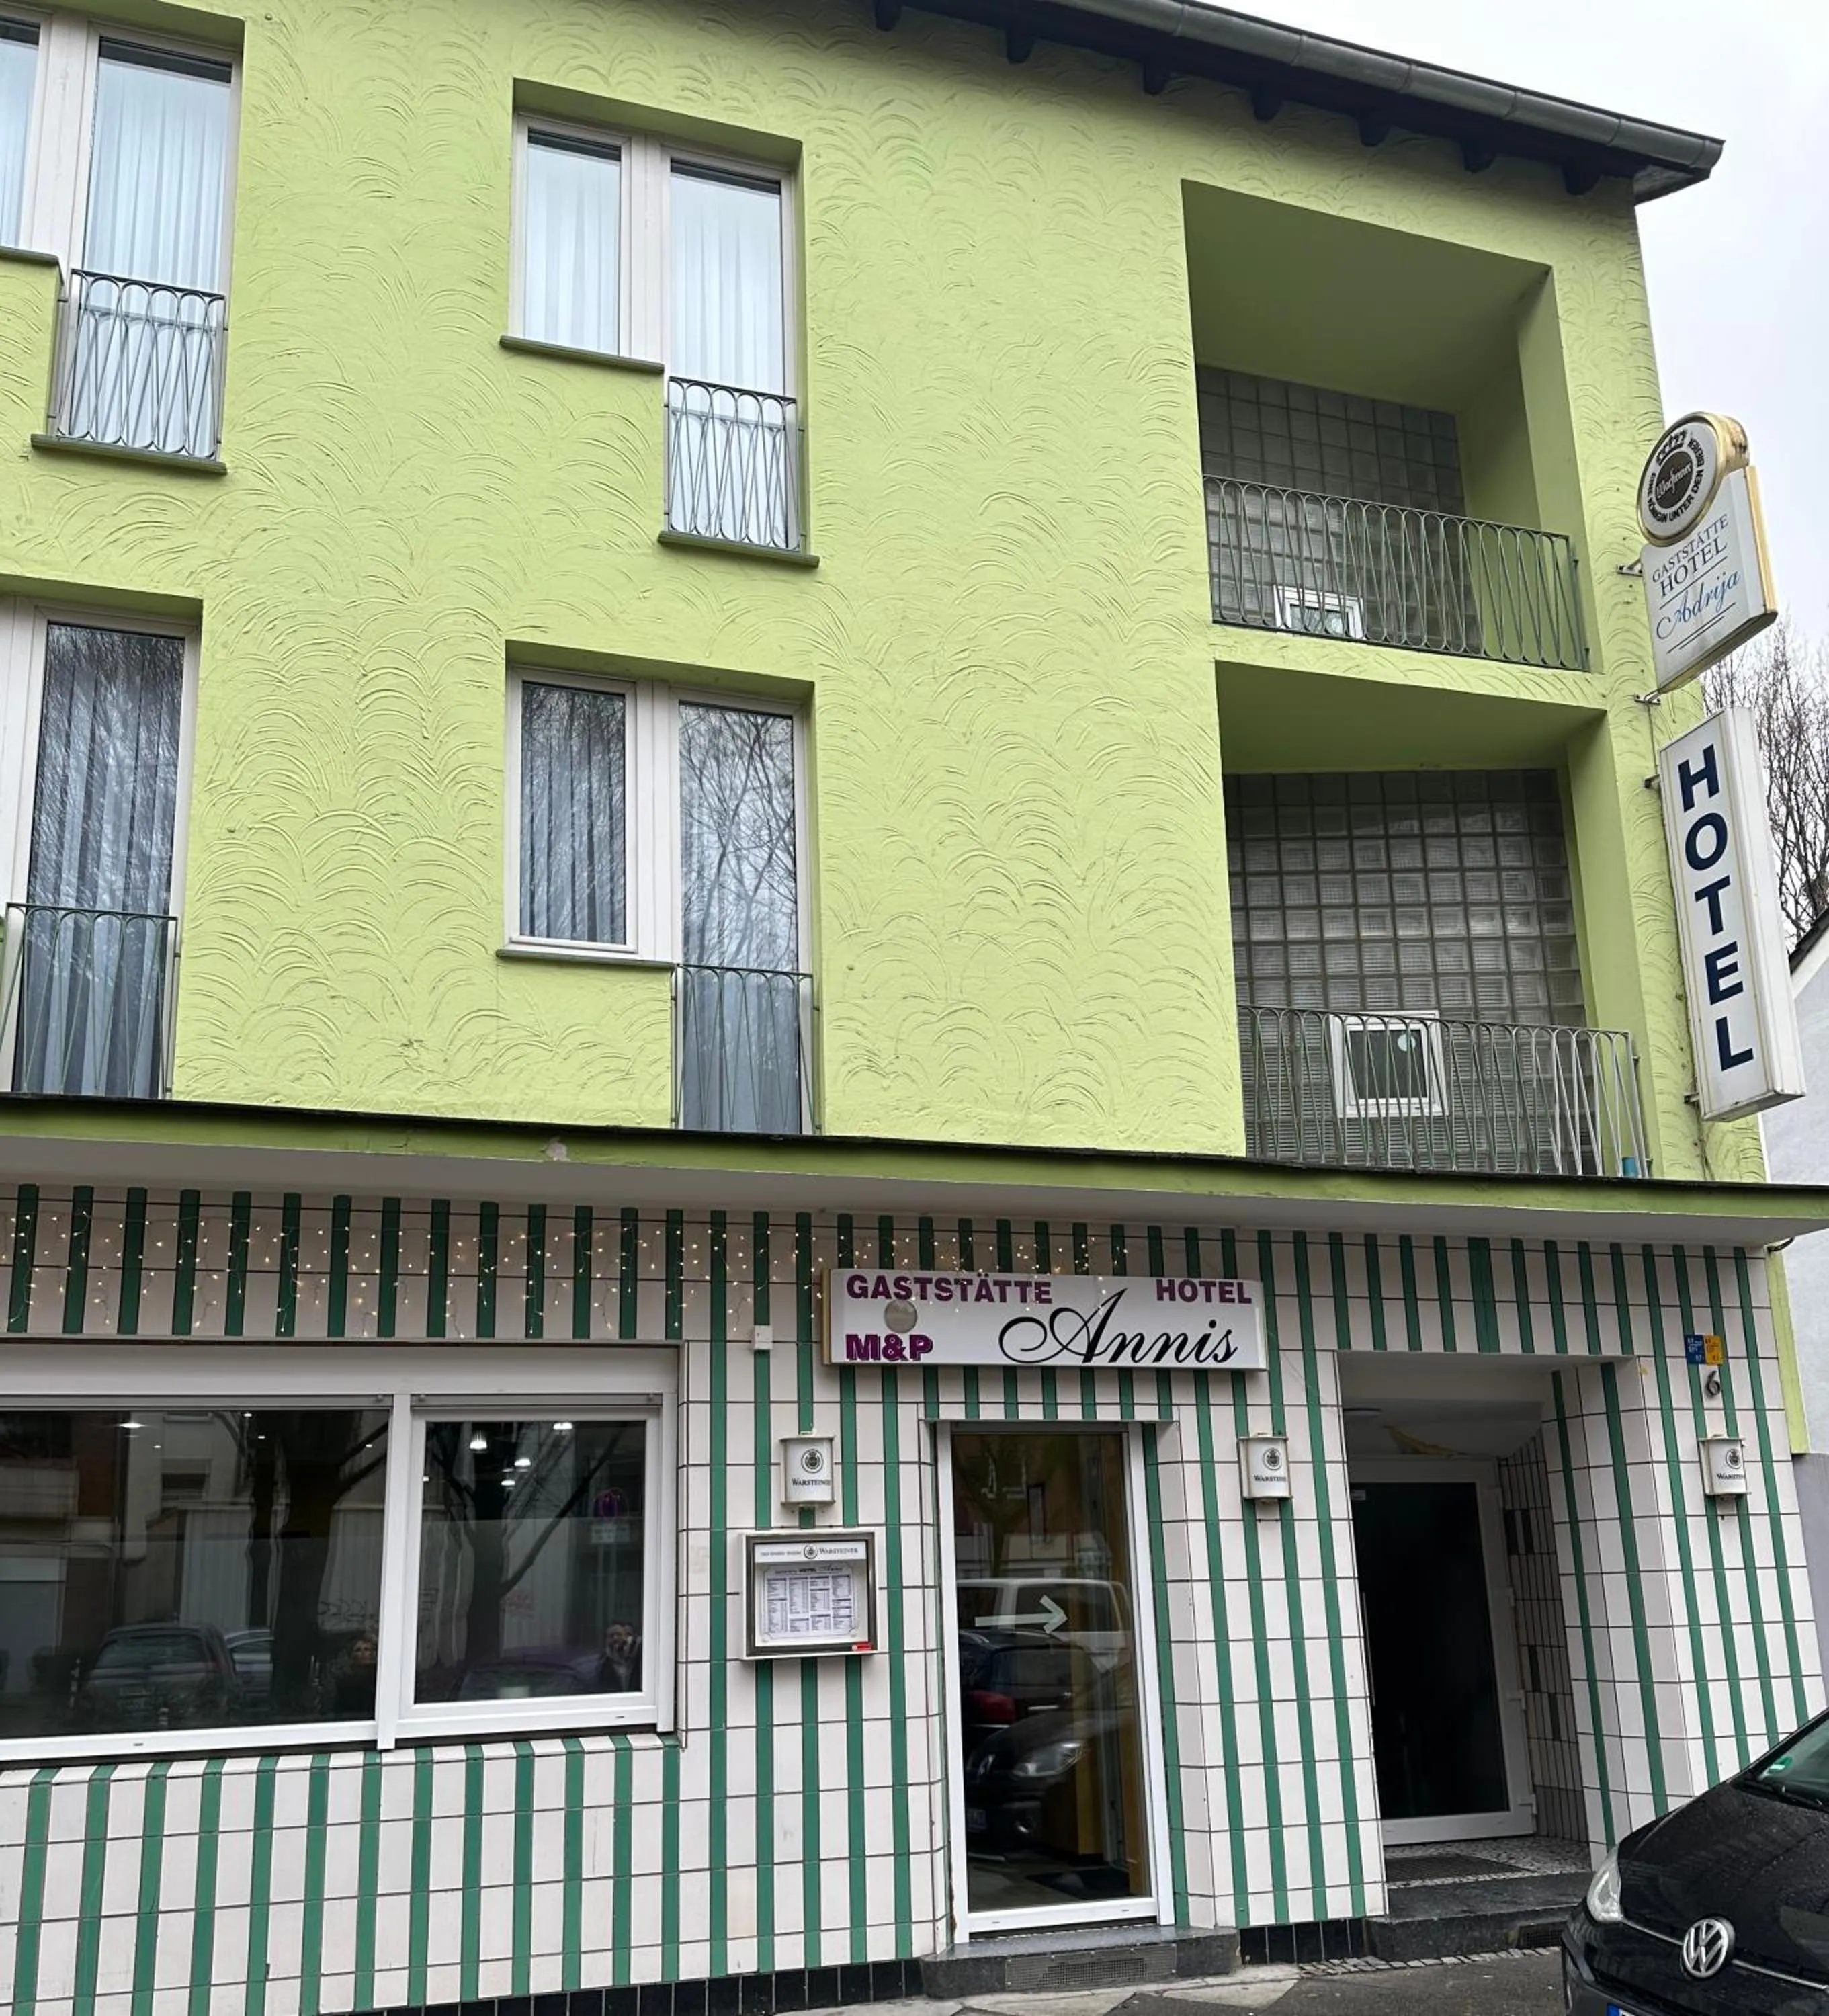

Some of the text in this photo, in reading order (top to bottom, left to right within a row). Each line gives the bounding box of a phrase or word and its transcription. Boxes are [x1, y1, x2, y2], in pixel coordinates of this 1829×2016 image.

[1669, 494, 1695, 522] UNTER
[1691, 469, 1705, 494] DEN
[1652, 513, 1729, 583] GASTSTÄTTE
[1660, 536, 1728, 597] HOTEL
[1656, 571, 1741, 639] Adrija
[1678, 744, 1754, 1073] HOTEL
[846, 1272, 1252, 1304] GASTSTÄTTE HOTEL
[845, 1334, 934, 1362] M&P
[998, 1287, 1239, 1364] Annis
[1705, 1370, 1721, 1396] 6
